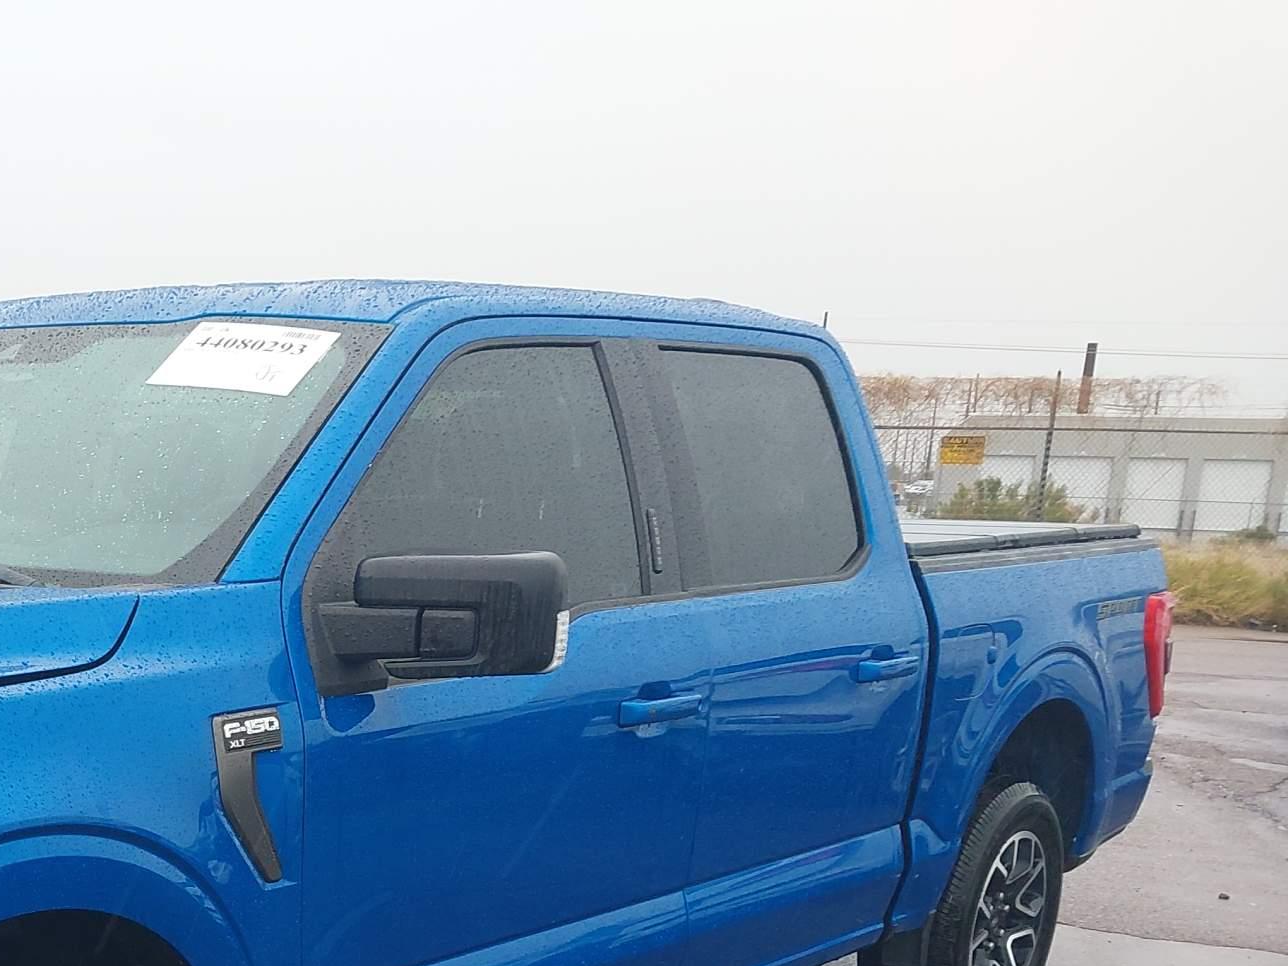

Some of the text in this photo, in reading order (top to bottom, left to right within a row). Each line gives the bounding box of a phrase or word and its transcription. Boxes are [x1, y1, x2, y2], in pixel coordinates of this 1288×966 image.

[197, 336, 308, 355] 44080293
[223, 716, 280, 738] F-150
[229, 739, 246, 749] XLT
